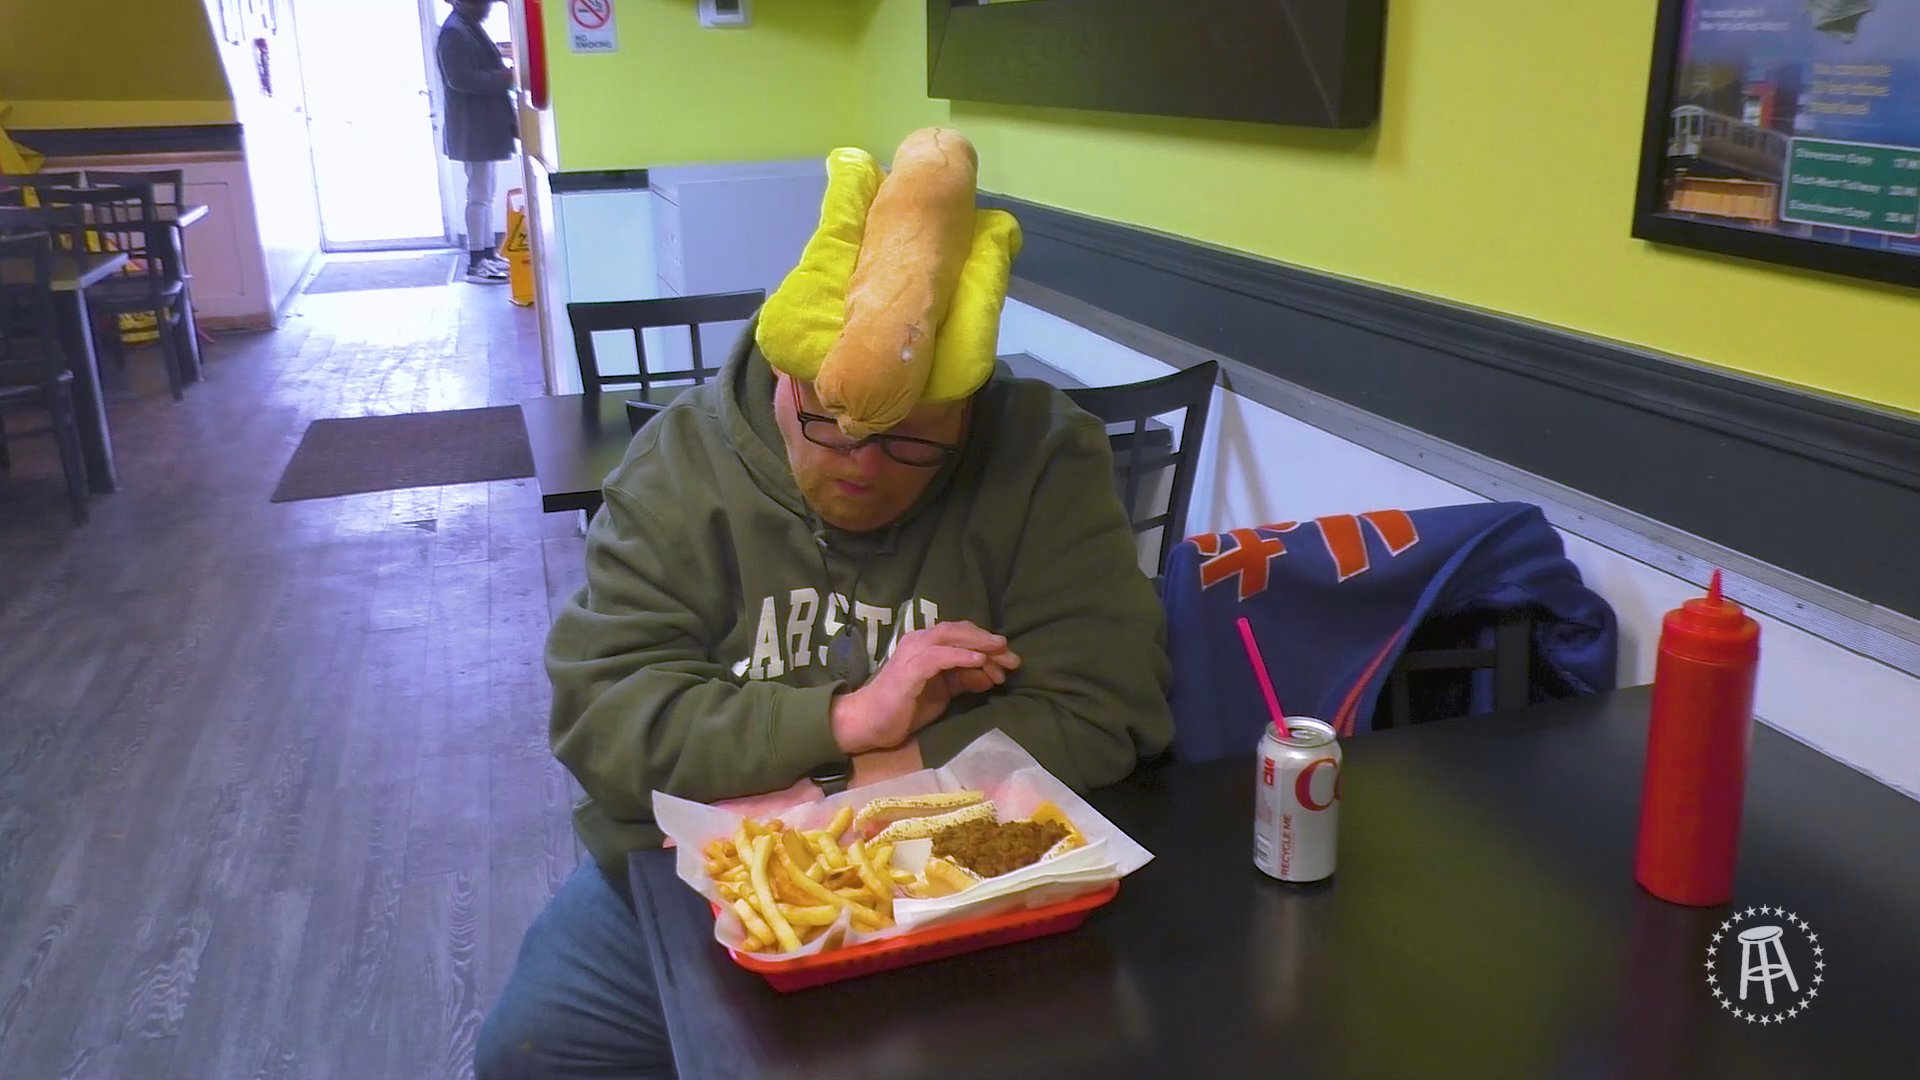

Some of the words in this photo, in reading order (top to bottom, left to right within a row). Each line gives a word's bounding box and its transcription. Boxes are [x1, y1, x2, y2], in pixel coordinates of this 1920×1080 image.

[575, 34, 588, 42] NO
[576, 41, 613, 49] SMOKING
[1295, 757, 1342, 812] C
[1283, 814, 1293, 831] ME
[1280, 832, 1292, 876] RECYCLE
